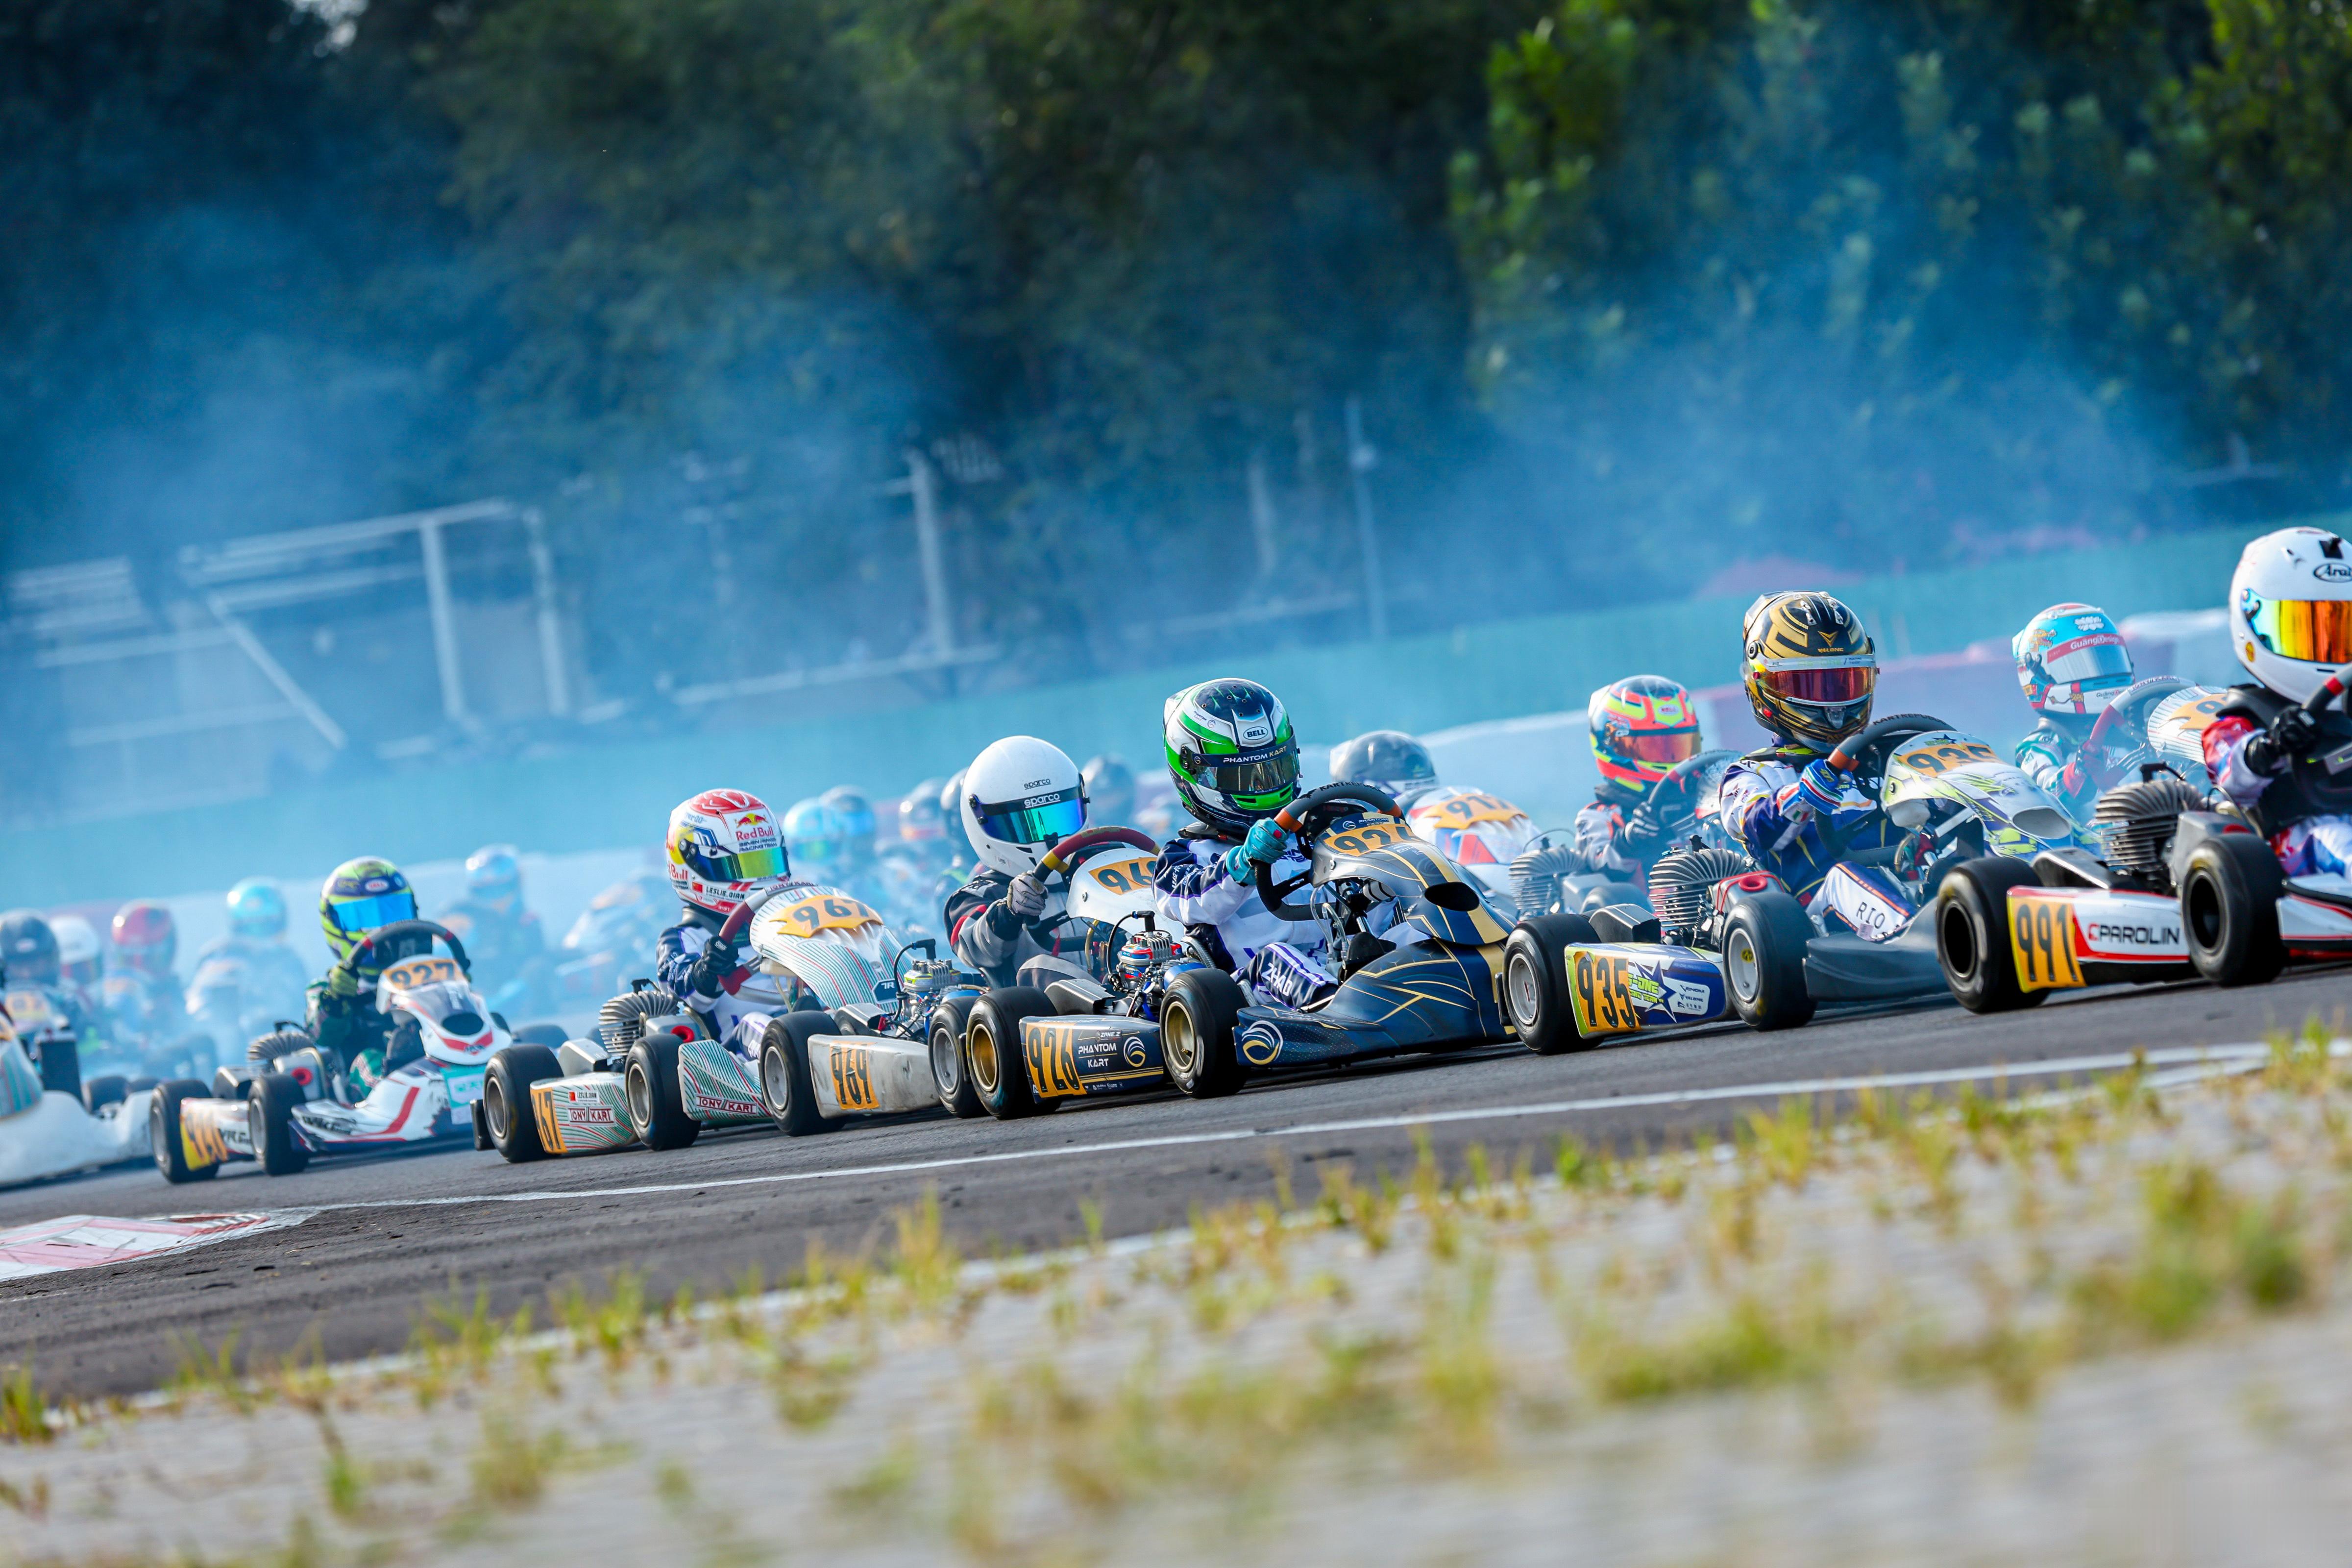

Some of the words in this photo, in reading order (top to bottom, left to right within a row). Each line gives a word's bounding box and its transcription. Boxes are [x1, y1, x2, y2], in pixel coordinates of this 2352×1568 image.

[1247, 729, 1265, 737] BELL
[1223, 753, 1268, 763] PHANTOM
[1269, 745, 1287, 758] KART
[1024, 778, 1051, 790] sparco
[1024, 793, 1061, 808] sparco
[735, 828, 757, 841] Red
[758, 826, 774, 837] Bull
[1856, 902, 1886, 930] RIO
[2017, 904, 2079, 982] 991
[1261, 962, 1294, 997] ZHAO
[1577, 957, 1636, 1028] 935
[1078, 1042, 1117, 1054] PHANTOM
[1029, 1027, 1080, 1092] 926
[1087, 1058, 1109, 1068] KART
[832, 1043, 872, 1104] 969
[696, 1096, 722, 1110] TONY
[728, 1101, 756, 1114] KART
[568, 1108, 586, 1122] TONY
[589, 1108, 613, 1123] KART
